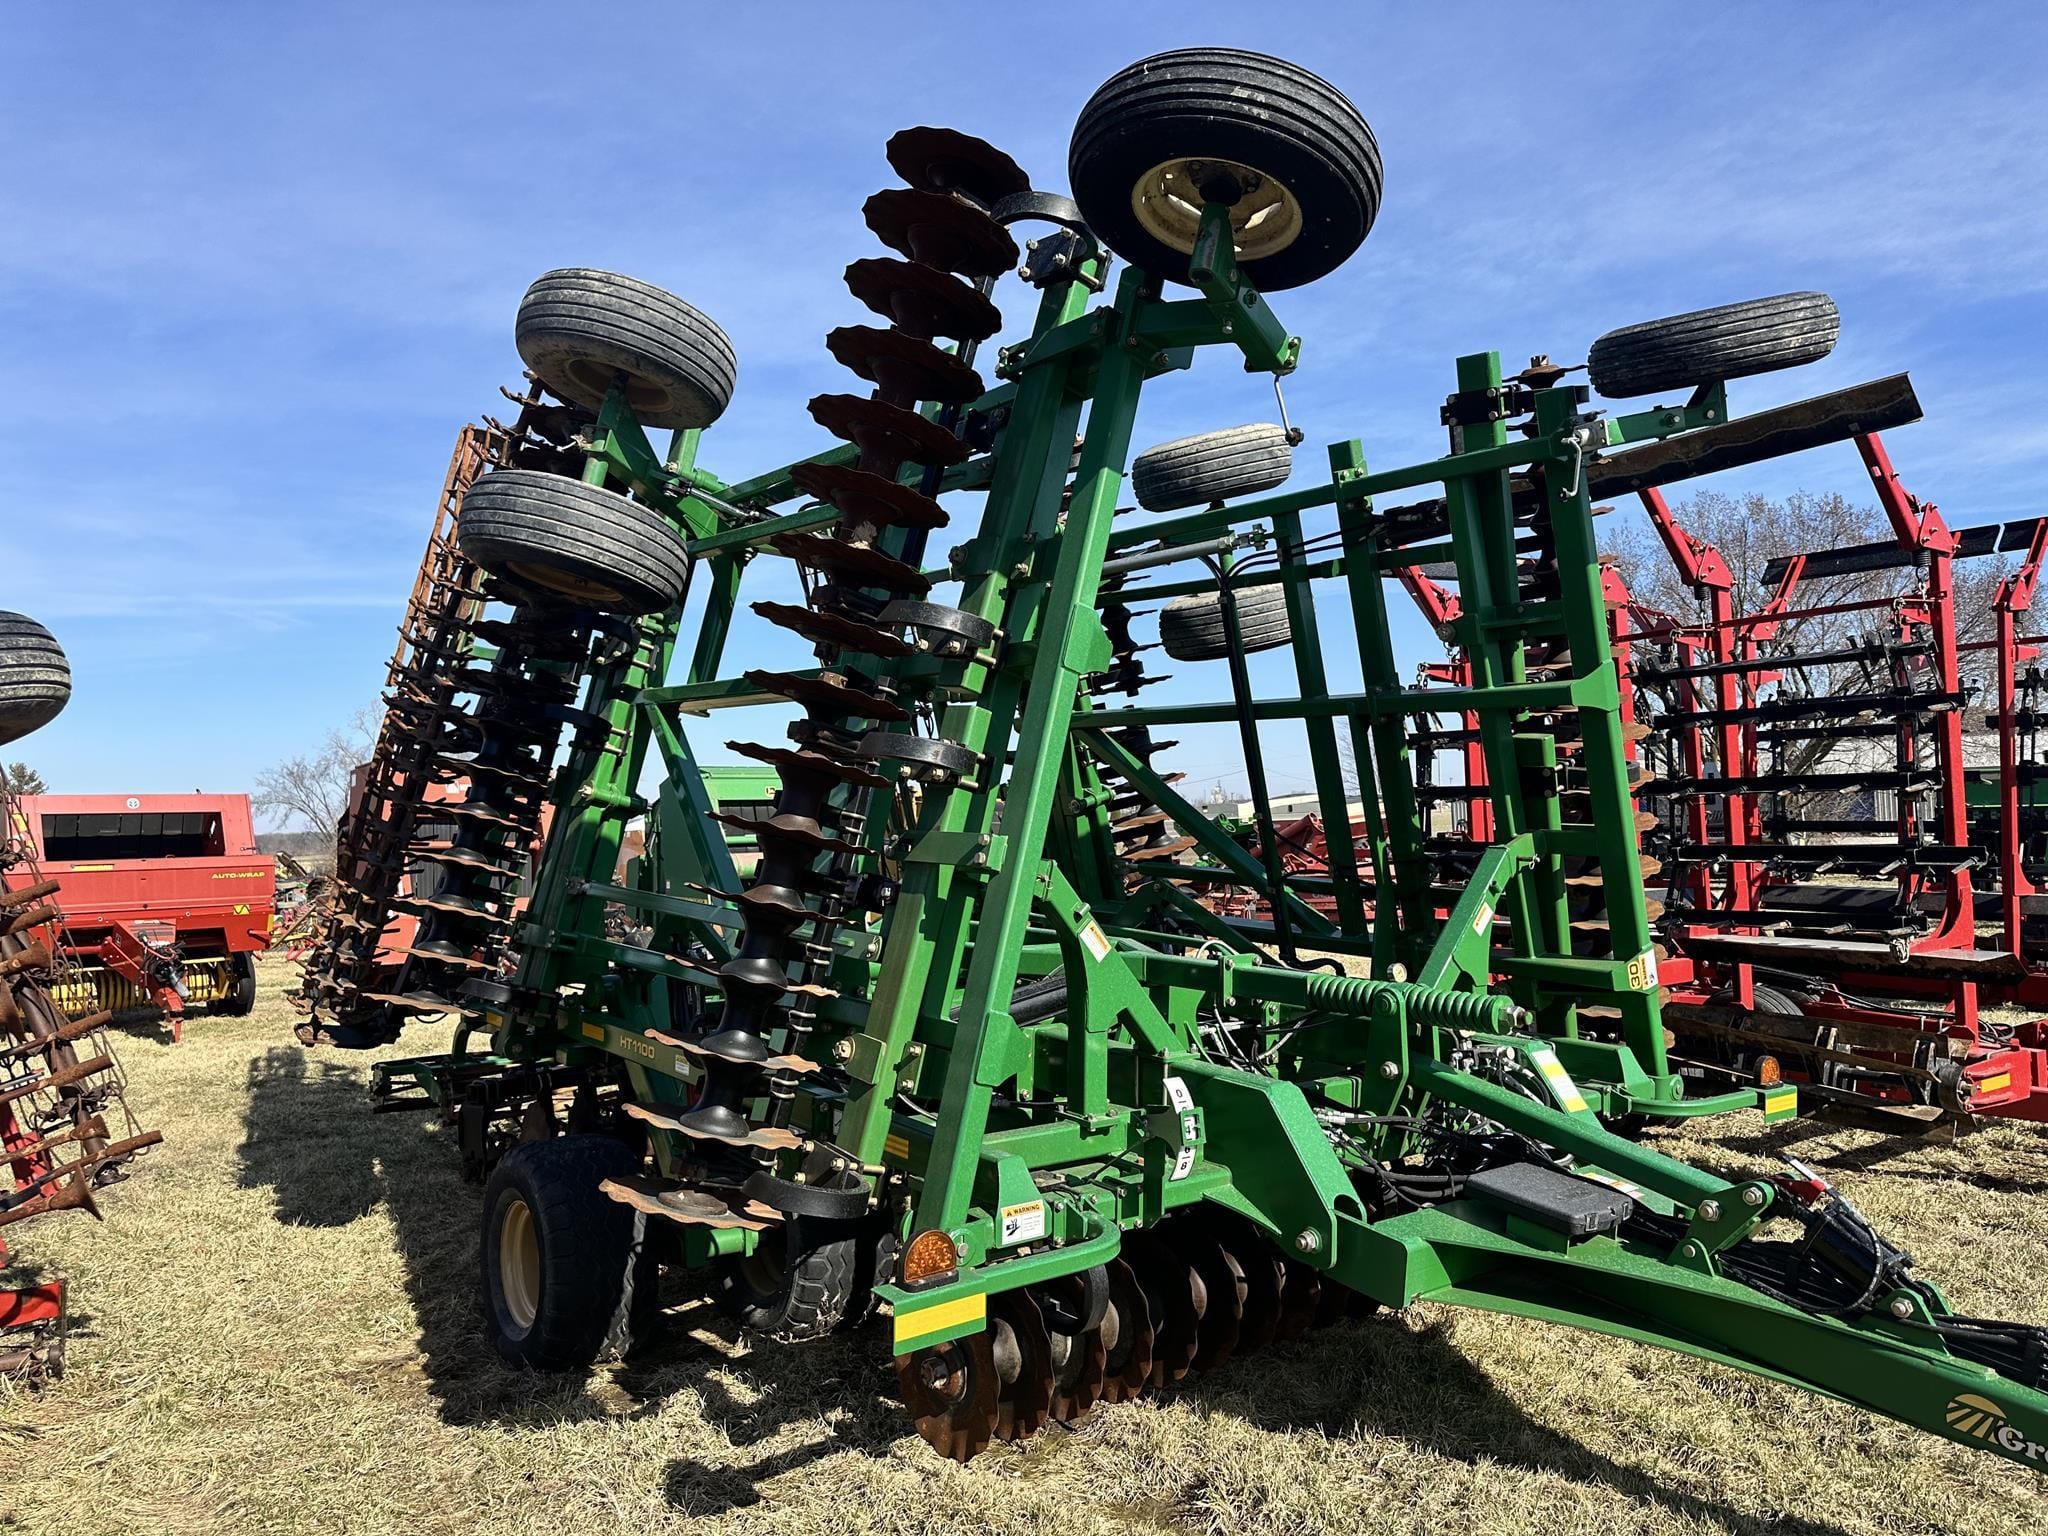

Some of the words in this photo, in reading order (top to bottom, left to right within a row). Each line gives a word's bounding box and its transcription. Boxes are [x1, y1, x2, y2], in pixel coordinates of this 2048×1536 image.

[211, 871, 266, 879] AUTO-WRAP
[1629, 963, 1640, 987] 30
[620, 1035, 655, 1059] HT1100
[1180, 1161, 1188, 1170] 8
[1013, 1203, 1040, 1214] WARNING
